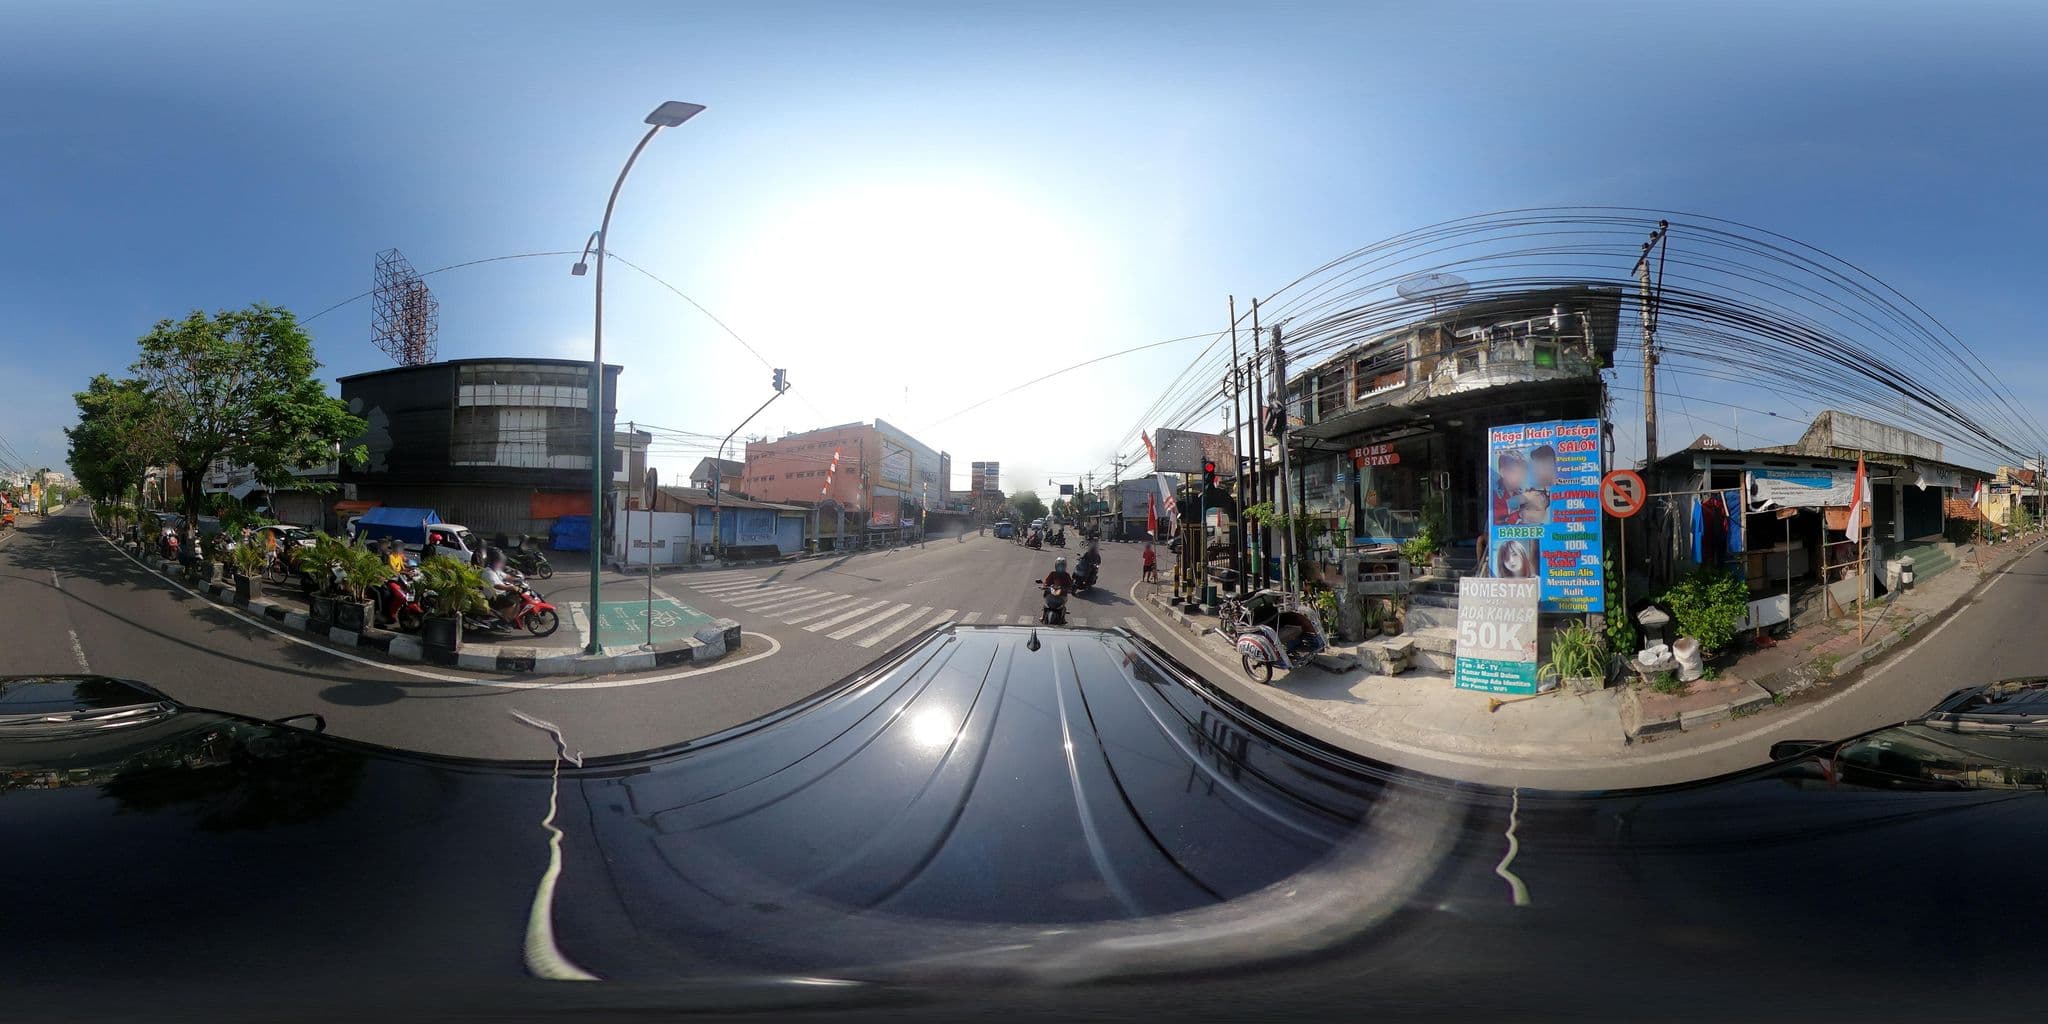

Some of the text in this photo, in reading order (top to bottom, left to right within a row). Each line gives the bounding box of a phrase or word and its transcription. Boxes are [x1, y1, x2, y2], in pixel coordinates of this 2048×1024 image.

[1493, 425, 1596, 443] Mega Hair Design
[1355, 445, 1387, 457] HOME
[1558, 440, 1596, 452] SALON
[1365, 455, 1391, 466] STAY
[1581, 476, 1600, 486] 50k
[1567, 522, 1585, 532] 50k
[1498, 527, 1544, 539] BARBER
[1565, 541, 1588, 551] 100k
[1581, 555, 1600, 565] 50k
[1549, 569, 1575, 577] Sulam
[1461, 582, 1535, 598] HOMESTAY
[1564, 588, 1584, 596] Kulit
[1460, 606, 1535, 622] ADA KAMAR
[1460, 619, 1523, 651] 50K
